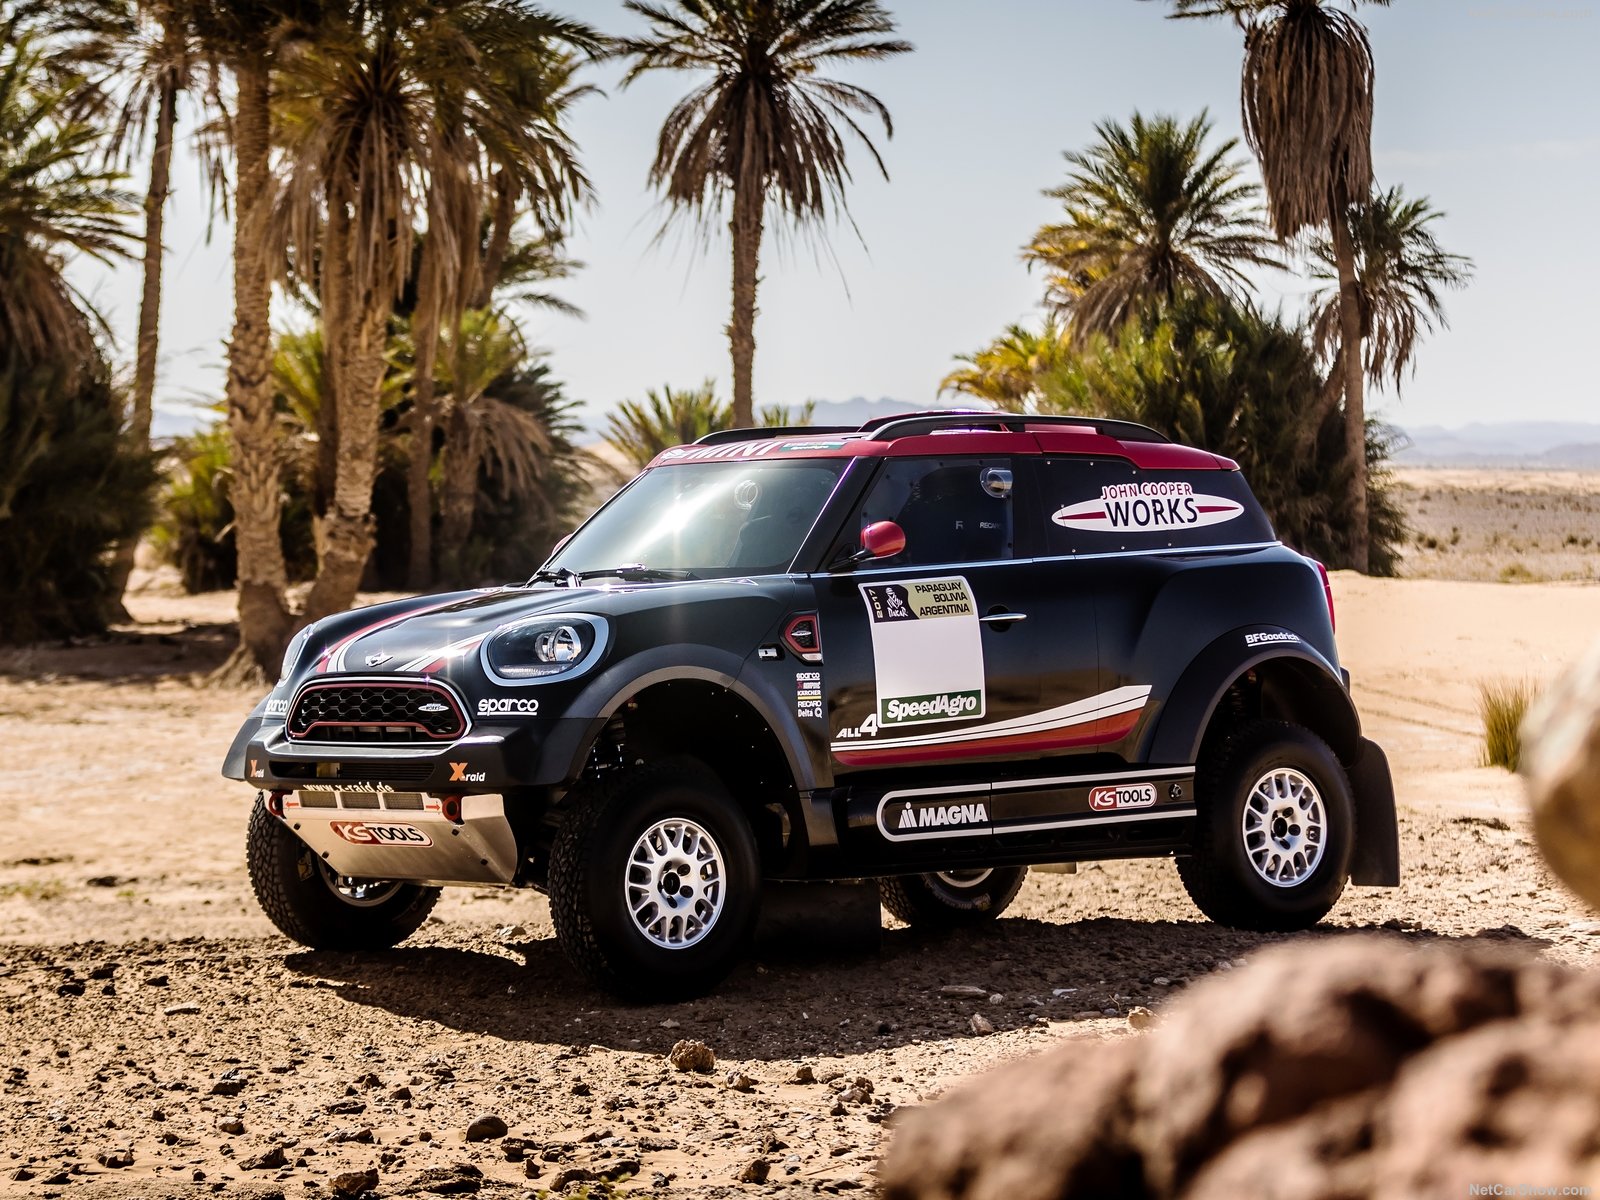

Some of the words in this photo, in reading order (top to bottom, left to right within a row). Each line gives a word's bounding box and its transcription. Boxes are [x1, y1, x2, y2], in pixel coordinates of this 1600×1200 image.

[1102, 484, 1138, 500] JOHN
[1142, 483, 1192, 497] COOPER
[1105, 498, 1198, 527] WORKS
[915, 582, 962, 594] PARAGUAY
[933, 592, 968, 603] BOLIVIA
[920, 603, 970, 616] ARGENTINA
[1245, 632, 1300, 645] BFGoodrich
[477, 698, 539, 716] sparco
[887, 694, 977, 721] SpeedAgro
[836, 713, 878, 738] ALL4
[919, 803, 988, 827] MAGNA
